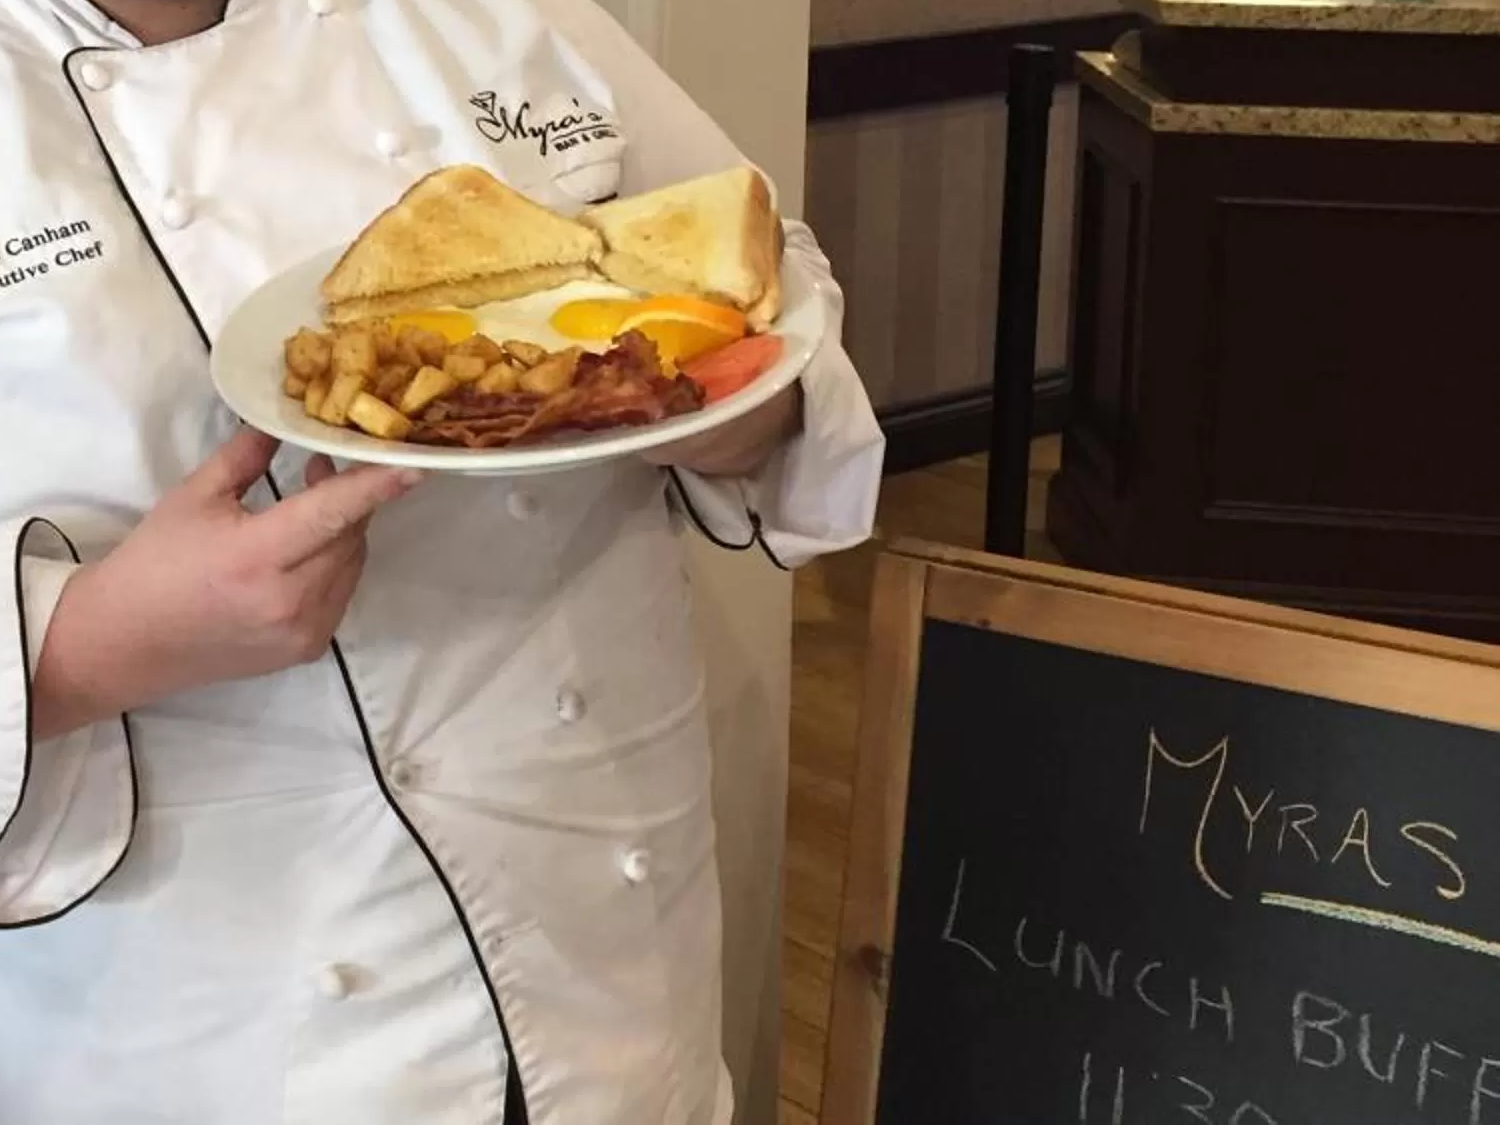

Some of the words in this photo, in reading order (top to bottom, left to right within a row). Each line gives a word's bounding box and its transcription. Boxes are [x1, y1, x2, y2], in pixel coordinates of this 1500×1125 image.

[475, 97, 603, 156] Myra's
[5, 219, 92, 257] Canham
[55, 240, 104, 267] Chef
[1138, 726, 1468, 900] MYRAS
[942, 858, 1236, 1043] LUNCH
